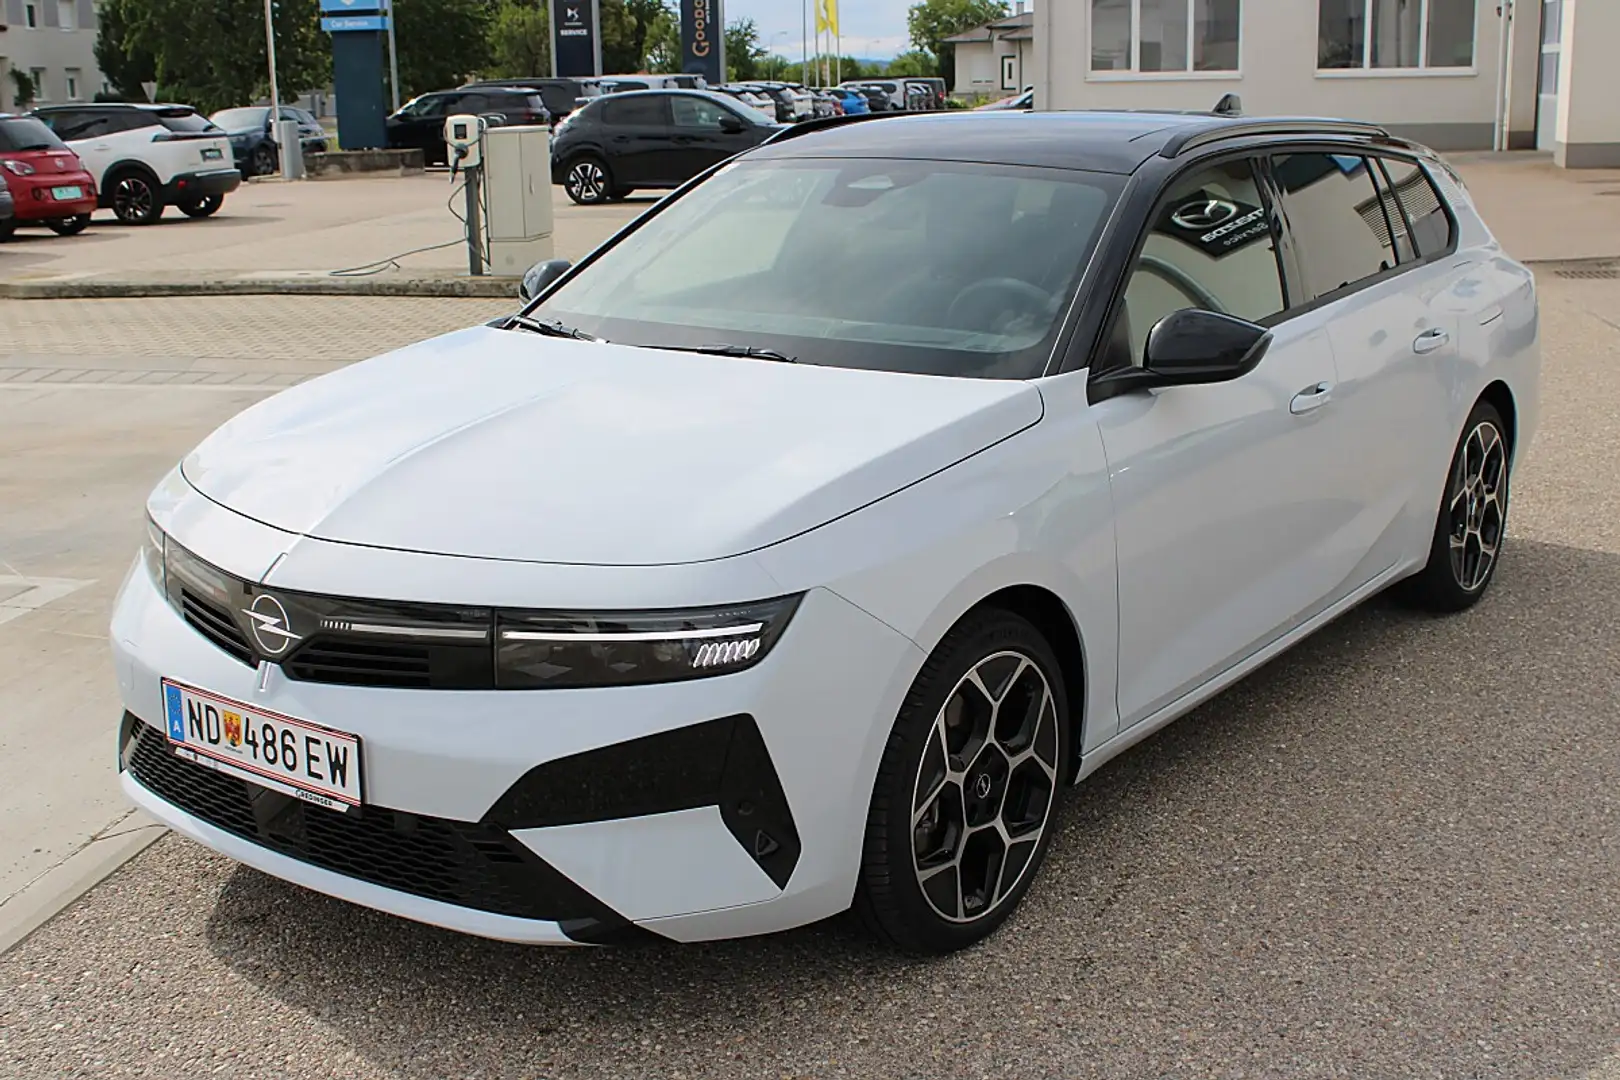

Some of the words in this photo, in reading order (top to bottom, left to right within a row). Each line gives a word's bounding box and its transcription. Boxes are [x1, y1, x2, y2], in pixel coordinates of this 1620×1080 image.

[173, 720, 181, 733] A
[187, 698, 221, 745] ND
[244, 717, 297, 772] 486
[304, 736, 348, 788] EW
